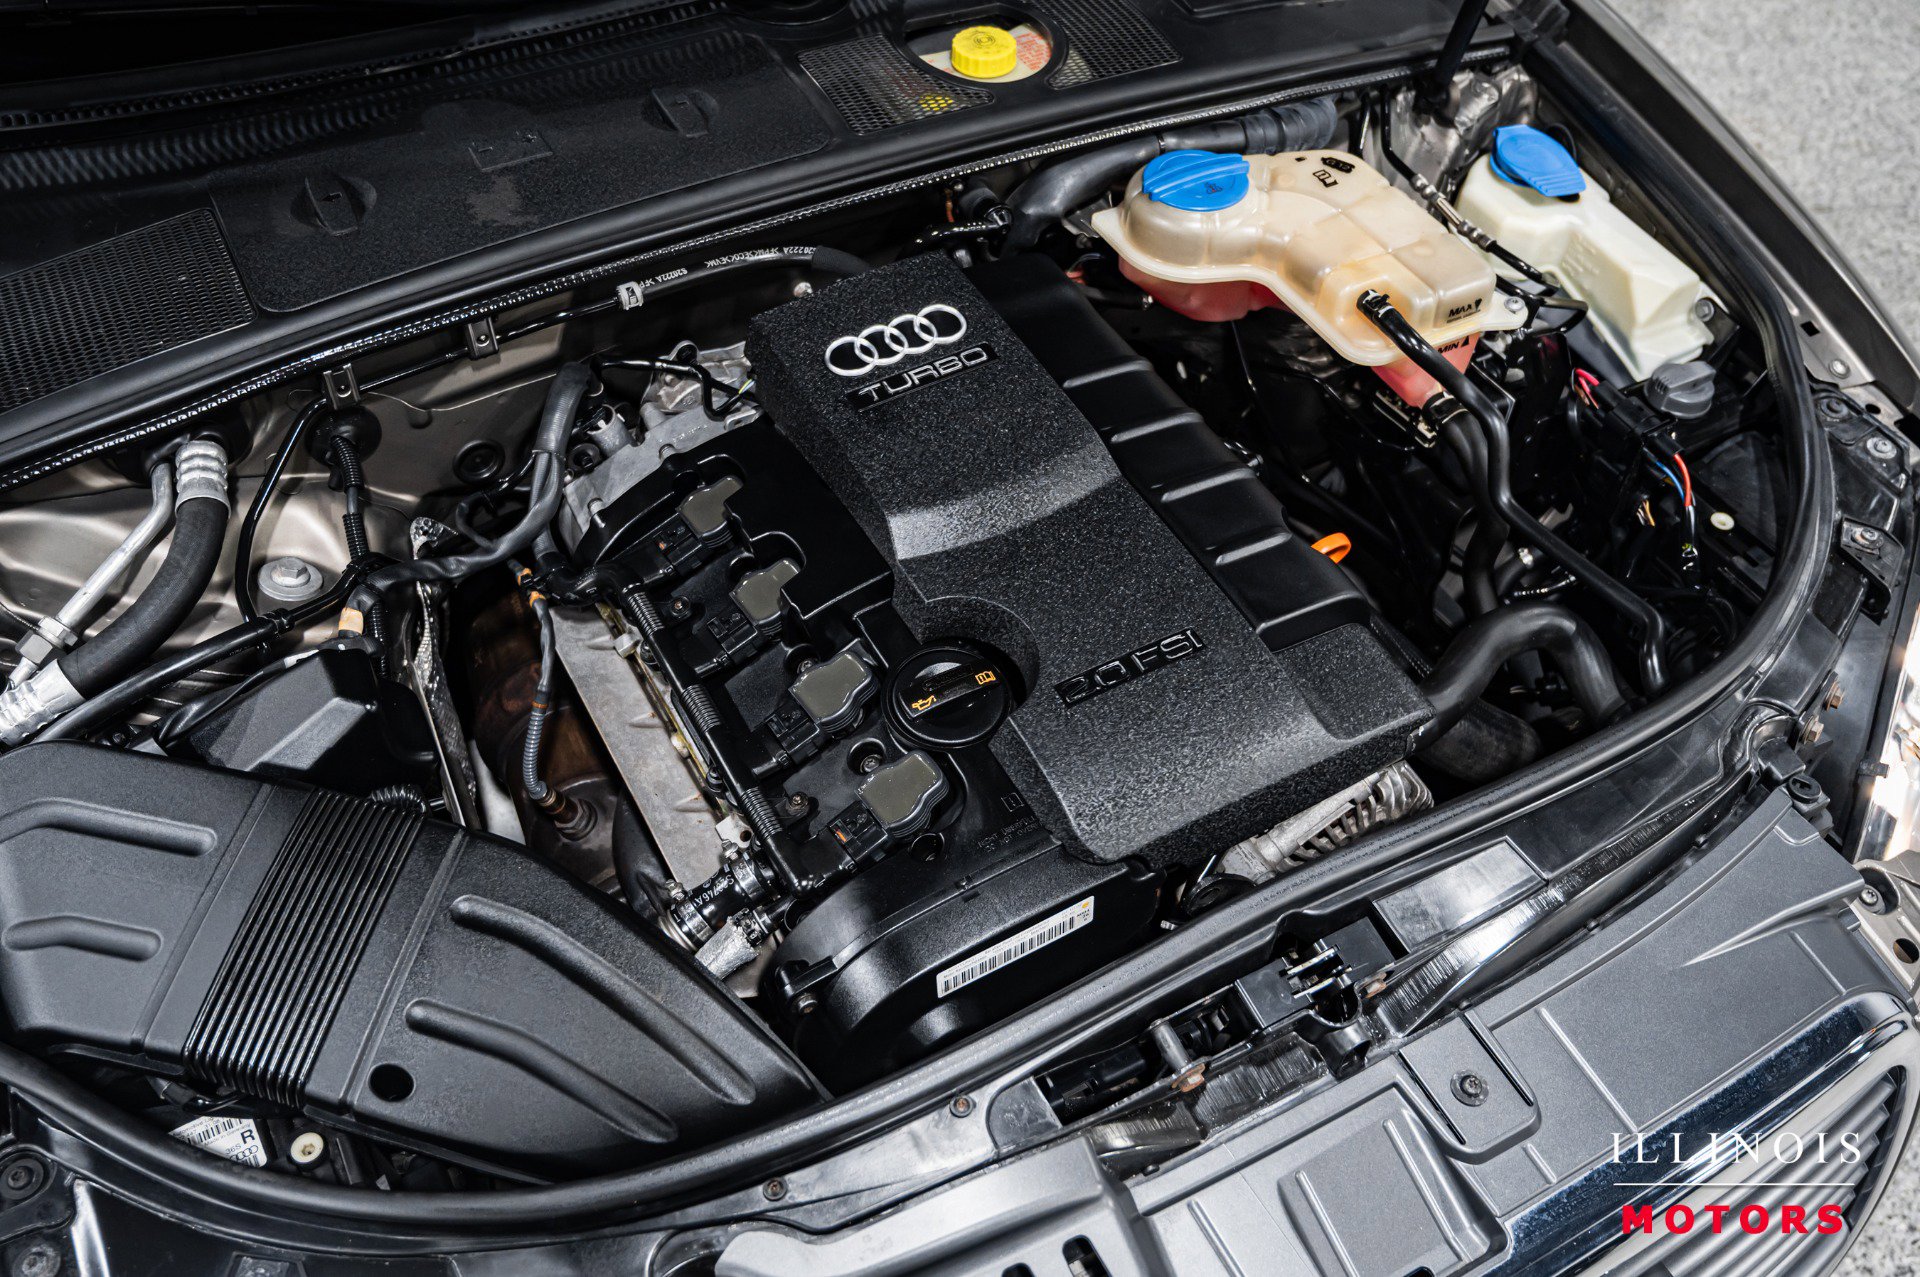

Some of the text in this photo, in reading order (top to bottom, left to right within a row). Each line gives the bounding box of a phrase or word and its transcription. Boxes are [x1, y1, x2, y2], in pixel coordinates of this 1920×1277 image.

[1448, 303, 1473, 317] MAX
[1437, 341, 1460, 353] MIN
[858, 347, 988, 401] TURBO
[1061, 630, 1203, 703] 2.0 FSI
[240, 1129, 256, 1144] R
[226, 1144, 241, 1155] 36S
